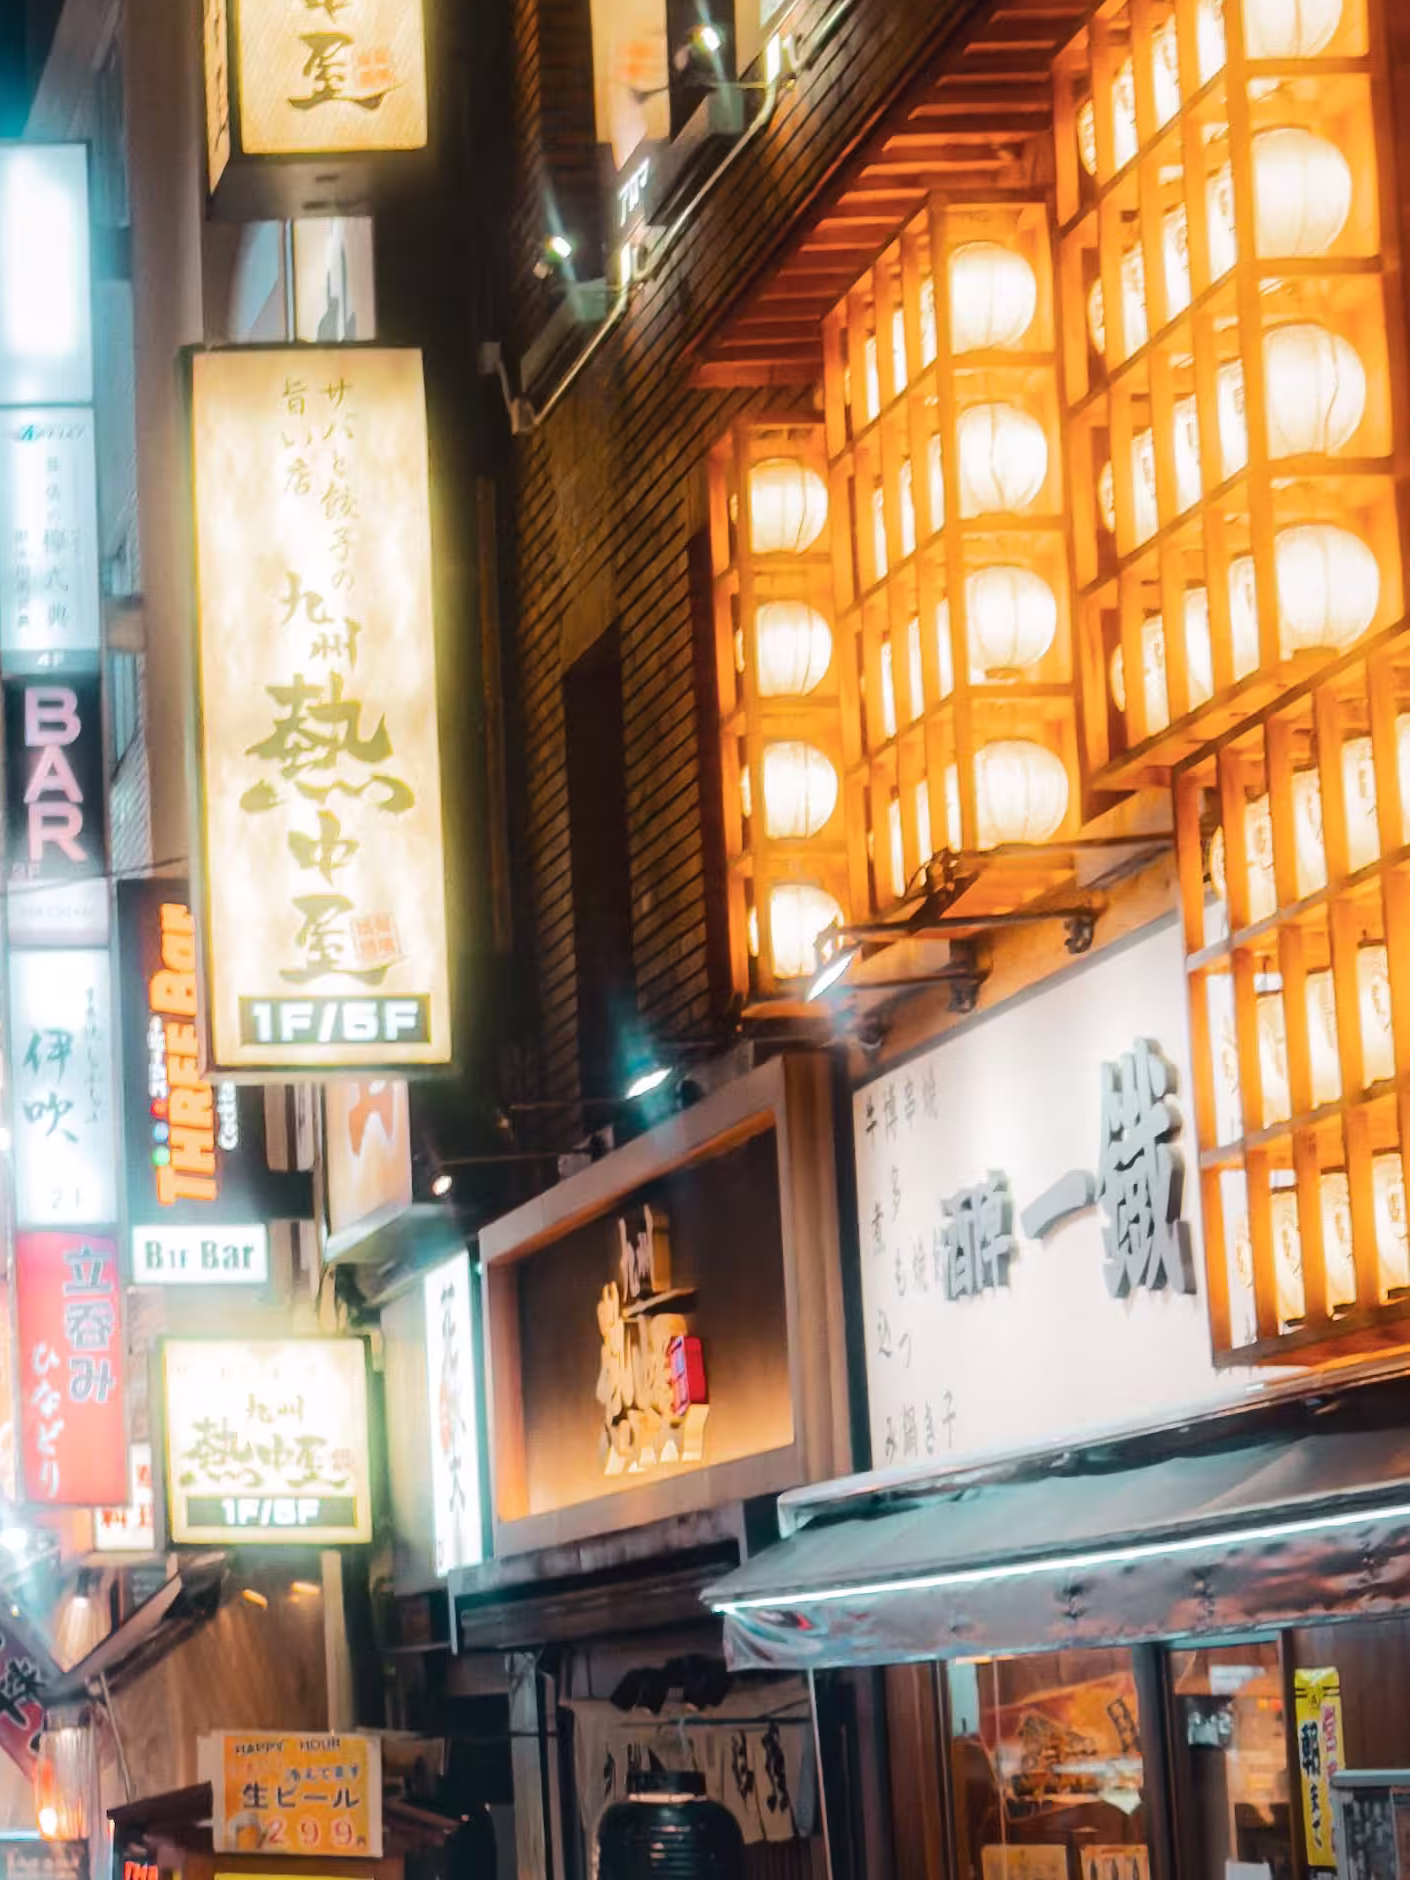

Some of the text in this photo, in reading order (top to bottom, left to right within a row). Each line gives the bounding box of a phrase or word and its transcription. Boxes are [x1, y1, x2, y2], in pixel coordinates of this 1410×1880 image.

[279, 377, 312, 499] 旨い店
[320, 377, 360, 593] サバと餃子の
[279, 569, 362, 671] 九州
[23, 687, 88, 863] BAR
[240, 672, 416, 986] 熱中屋
[22, 1027, 78, 1143] 伊吹
[154, 1021, 217, 1206] THREE
[62, 1245, 114, 1403] 立呑み
[200, 1241, 255, 1270] Bar
[31, 1342, 61, 1498] ひなどり
[235, 1737, 341, 1756] HAPPY HOUR
[242, 1781, 361, 1810] 生ビール
